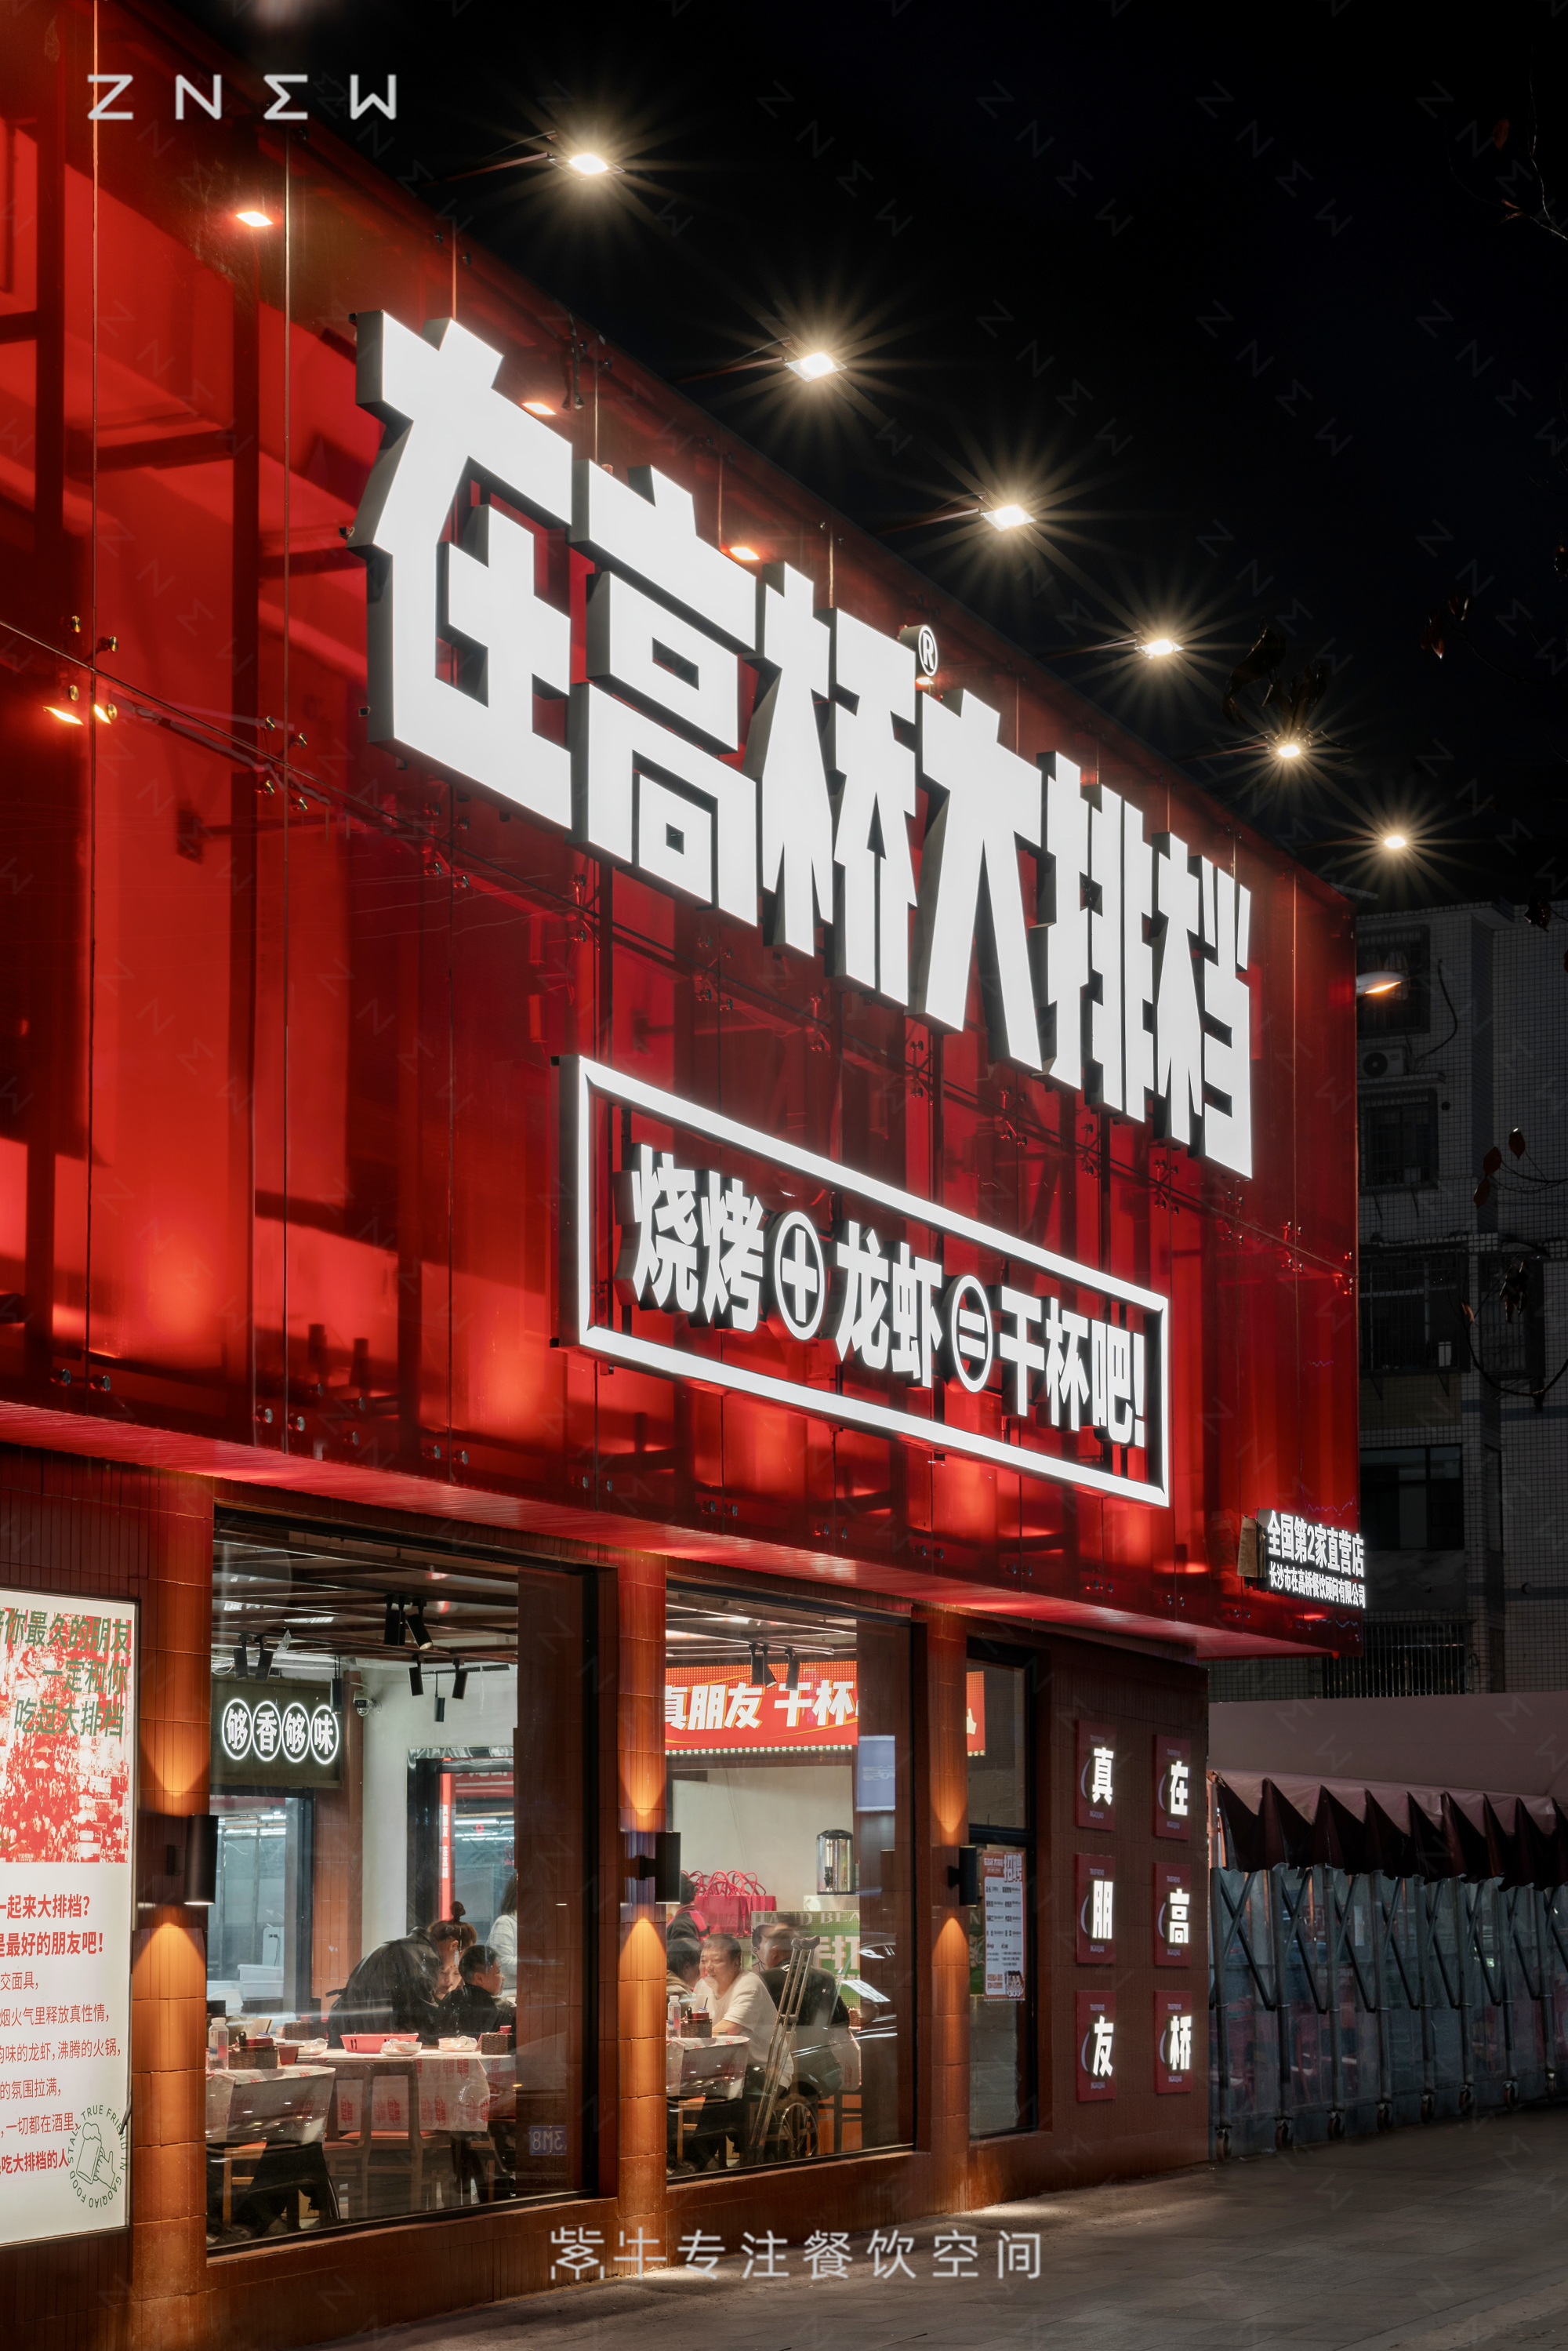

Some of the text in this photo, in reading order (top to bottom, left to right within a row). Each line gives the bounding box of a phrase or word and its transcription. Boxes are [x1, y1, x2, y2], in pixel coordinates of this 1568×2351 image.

[1268, 1510, 1364, 1578] 全国第2家直营店
[0, 1608, 132, 1654] 你最久的朋友
[43, 1657, 129, 1695] 一定和你
[14, 1697, 125, 1738] 吃过大排档
[774, 1679, 858, 1727] 干杯
[227, 1708, 335, 1755] 够香够味
[1092, 1747, 1114, 1805] 真
[1170, 1761, 1189, 1815] 在
[753, 1912, 813, 1927] HAD
[1092, 1880, 1113, 1939] 朋
[1169, 1888, 1189, 1943] 高
[1093, 2015, 1113, 2077] 友
[1170, 2015, 1192, 2070] 桥
[81, 2105, 103, 2120] TRUE
[67, 2123, 81, 2164] STALL
[119, 2157, 128, 2171] IN
[70, 2170, 87, 2203] FOOD
[89, 2176, 122, 2209] GAOQIAO
